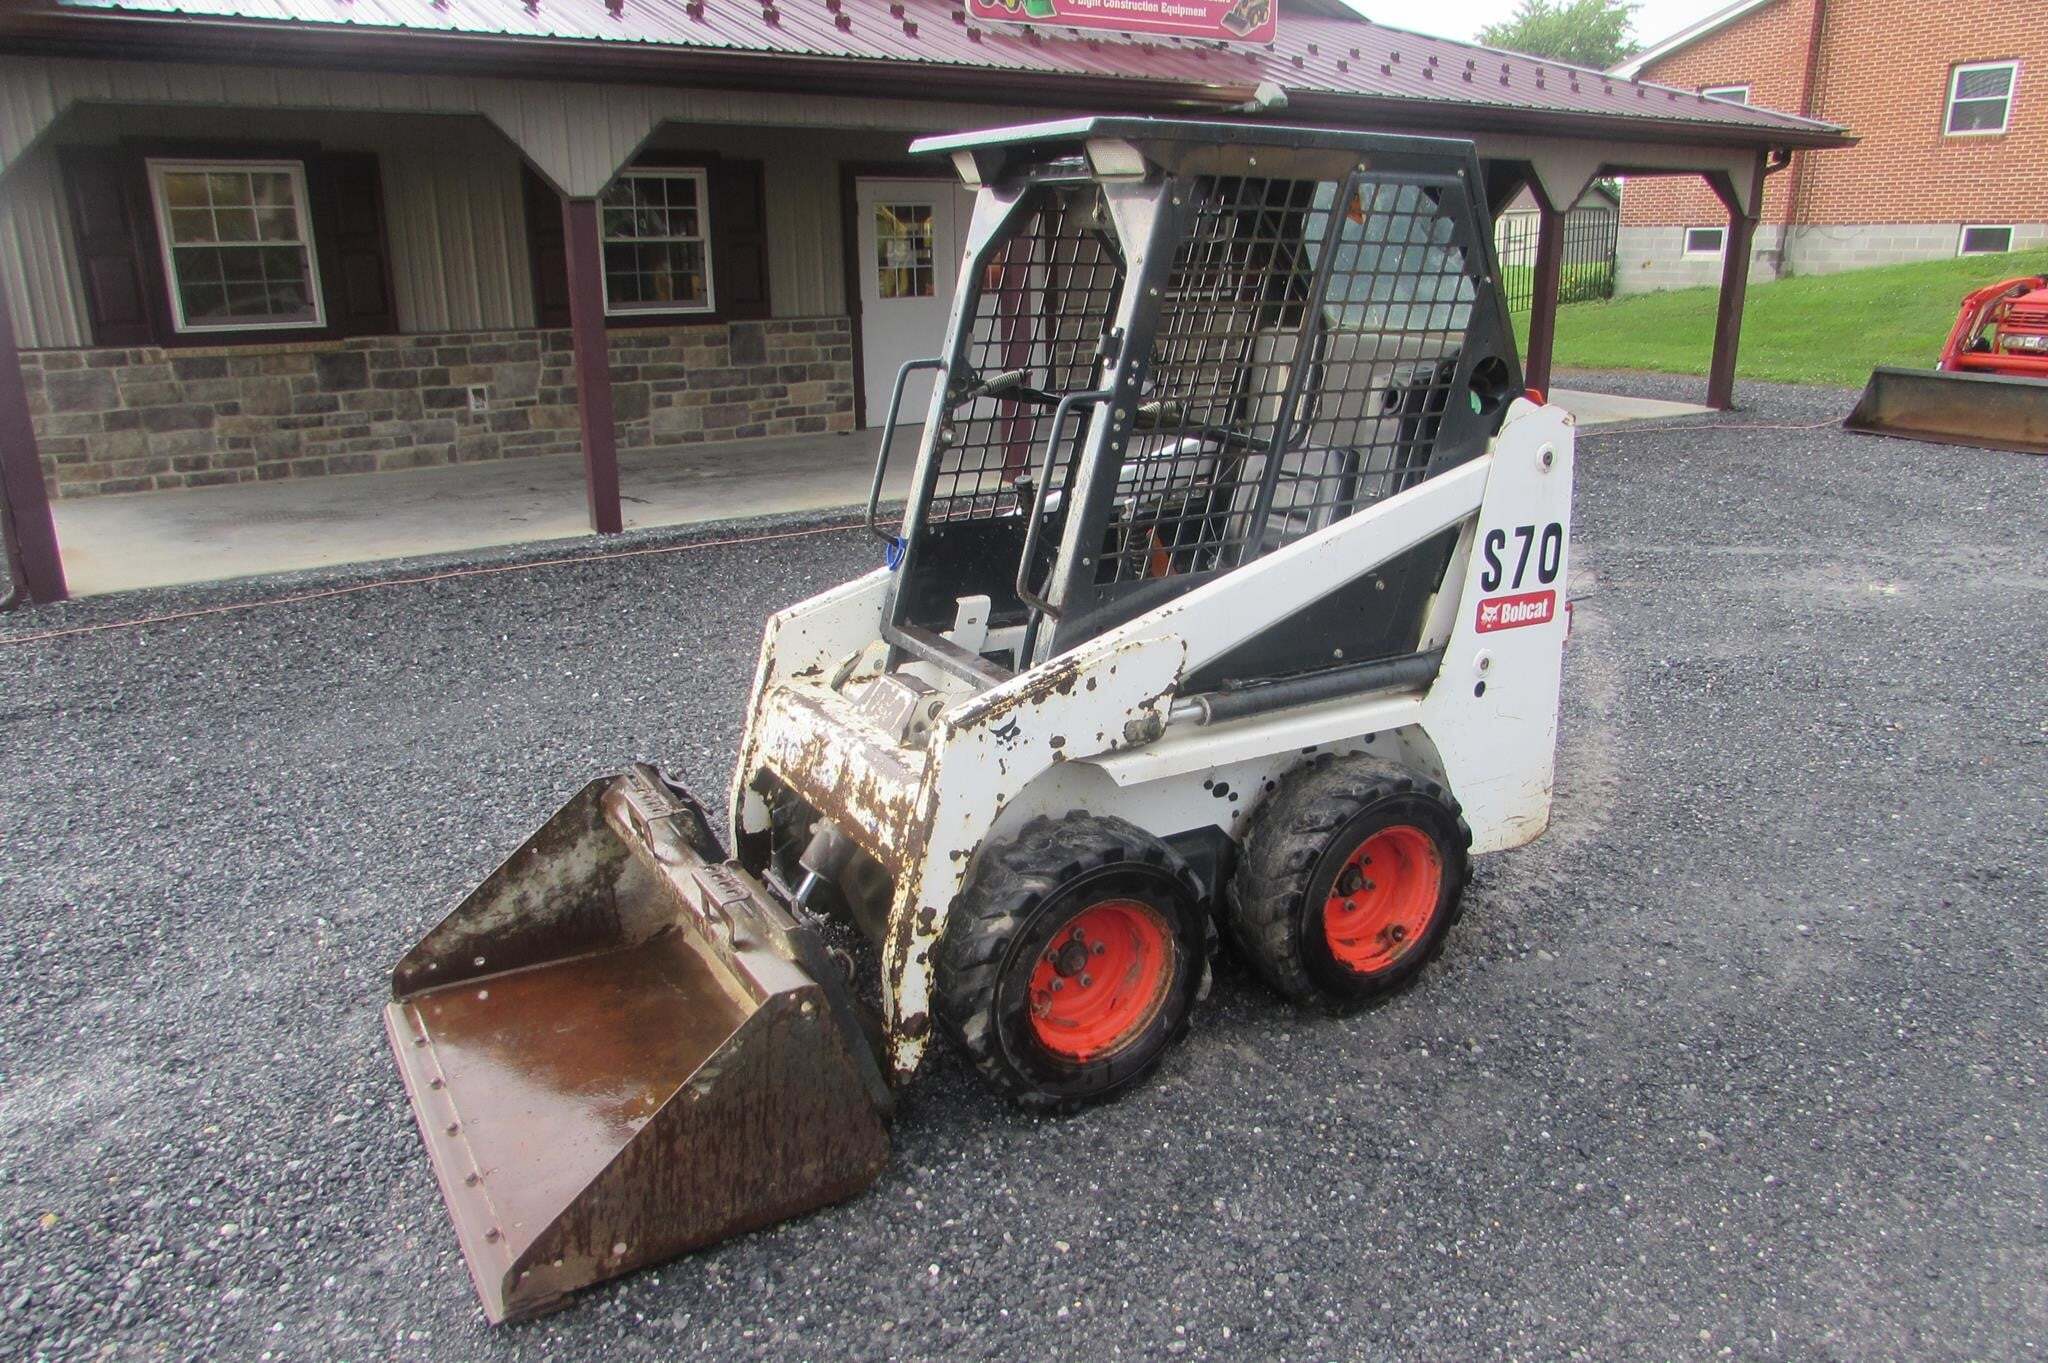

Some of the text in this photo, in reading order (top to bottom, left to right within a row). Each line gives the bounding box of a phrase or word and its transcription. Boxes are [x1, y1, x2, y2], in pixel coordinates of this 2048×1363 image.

[1104, 0, 1158, 12] Construction
[1161, 2, 1207, 17] Equipment
[1481, 522, 1562, 593] S70
[1501, 599, 1548, 624] Bobcat
